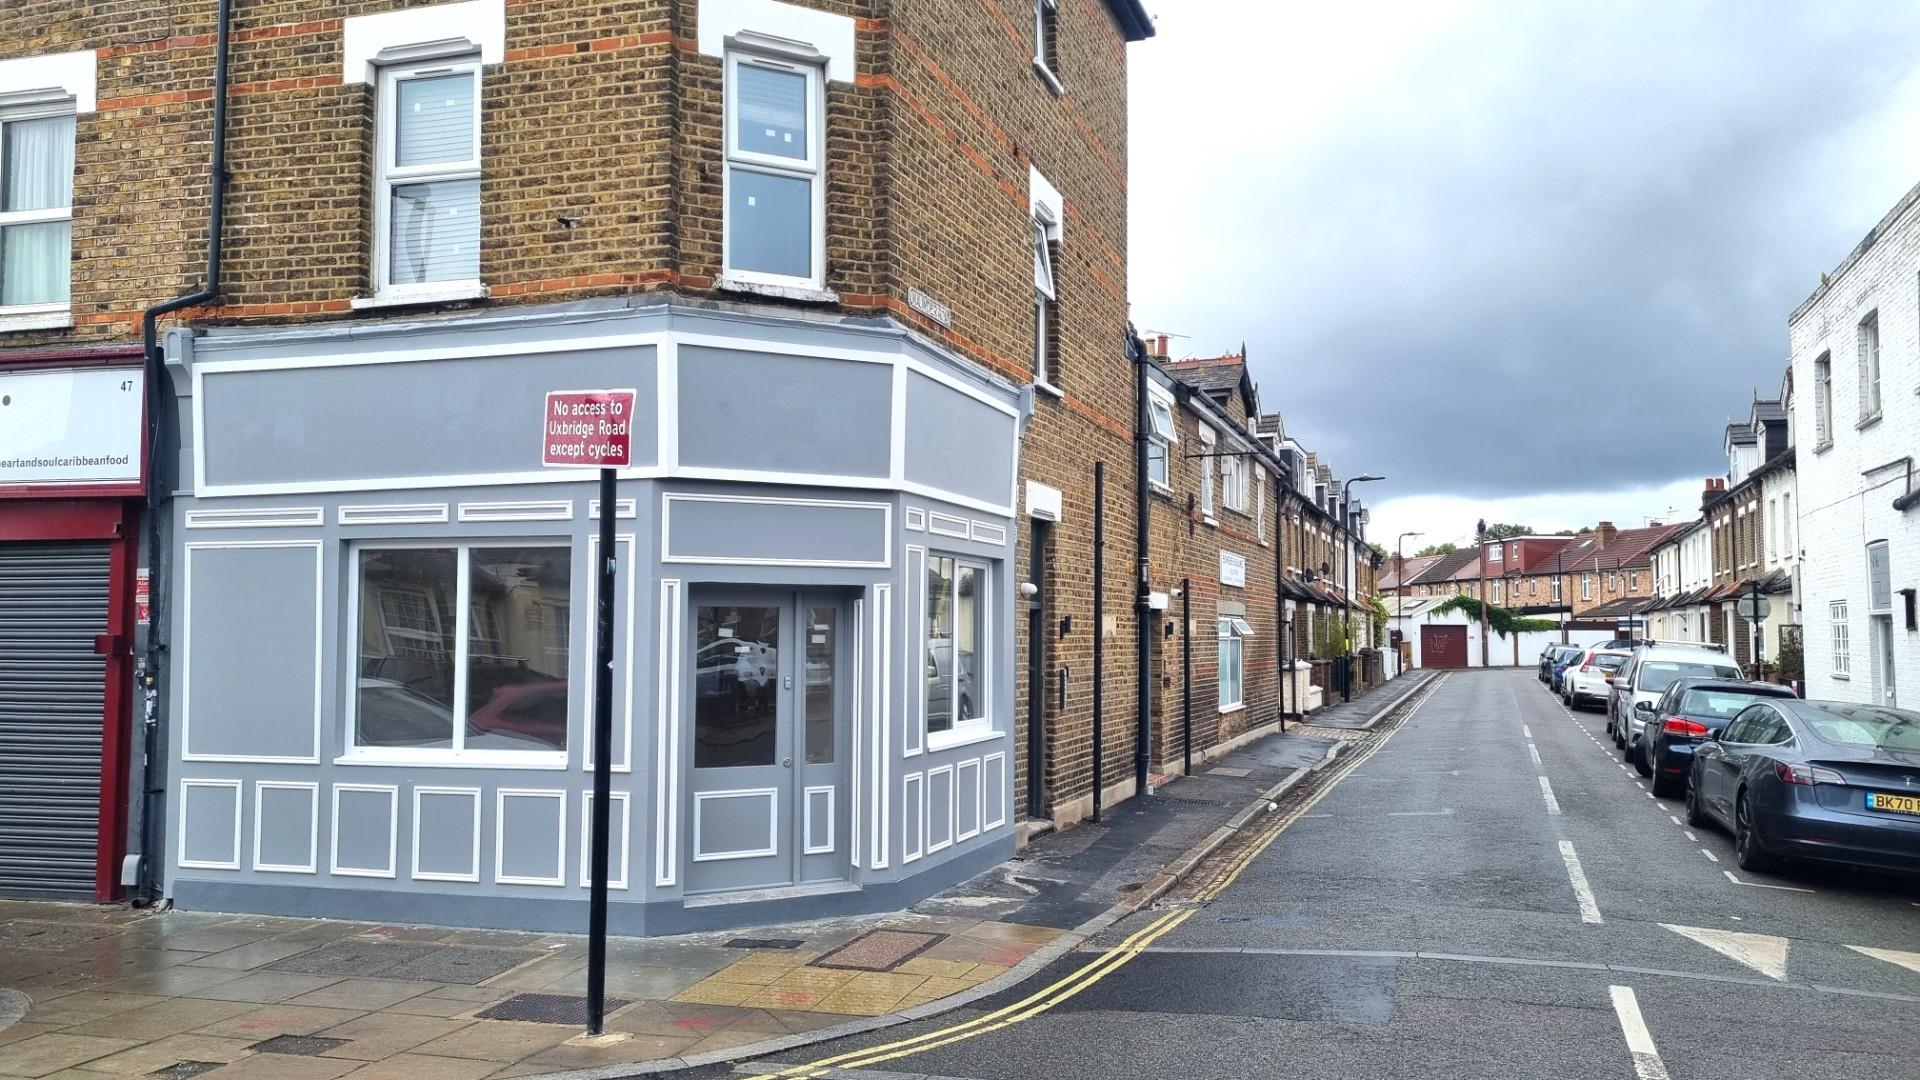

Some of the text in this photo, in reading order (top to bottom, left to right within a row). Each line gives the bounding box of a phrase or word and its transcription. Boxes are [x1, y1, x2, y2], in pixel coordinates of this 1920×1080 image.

[120, 380, 134, 392] 47
[553, 399, 623, 416] No access to
[549, 420, 626, 438] Uxbridge Road
[550, 441, 623, 459] except cycles
[1876, 795, 1913, 810] BK70
